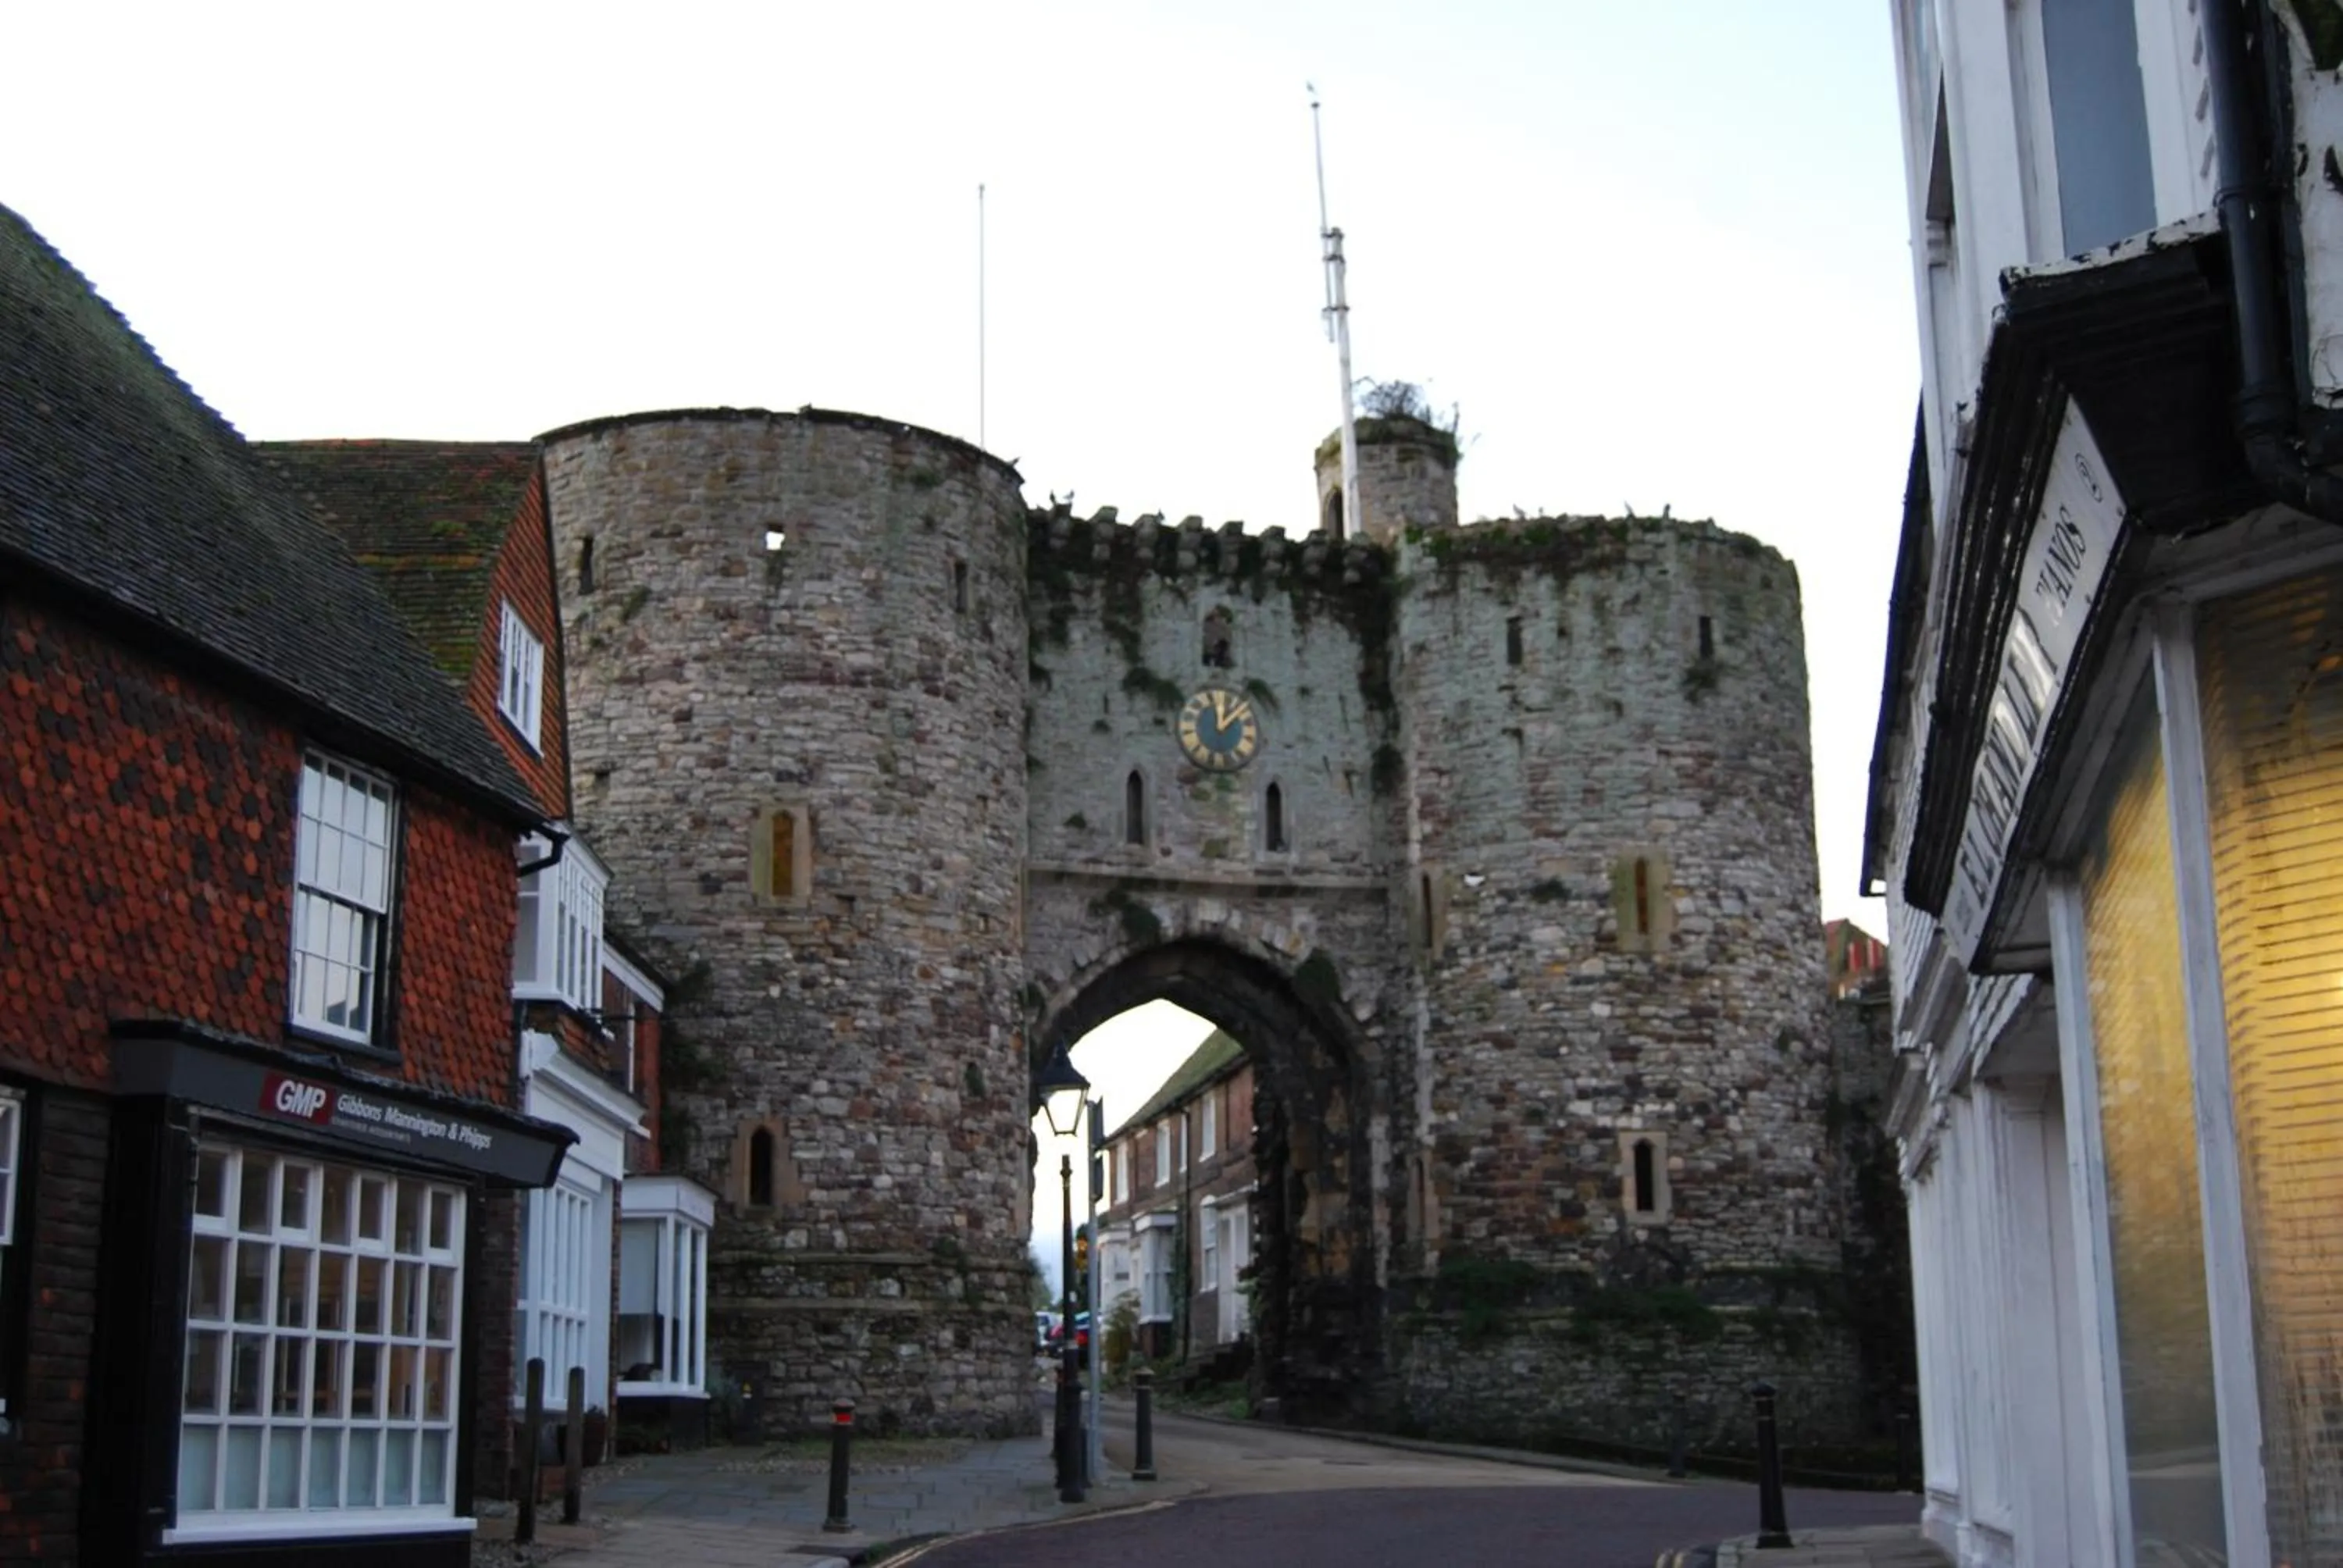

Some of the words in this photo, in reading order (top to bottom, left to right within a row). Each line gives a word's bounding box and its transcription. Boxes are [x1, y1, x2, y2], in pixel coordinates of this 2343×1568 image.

[276, 1080, 326, 1118] GMP
[337, 1094, 382, 1121] Gibbons
[384, 1106, 446, 1137] Mannington
[448, 1121, 458, 1140] &
[459, 1124, 493, 1149] Phipps
